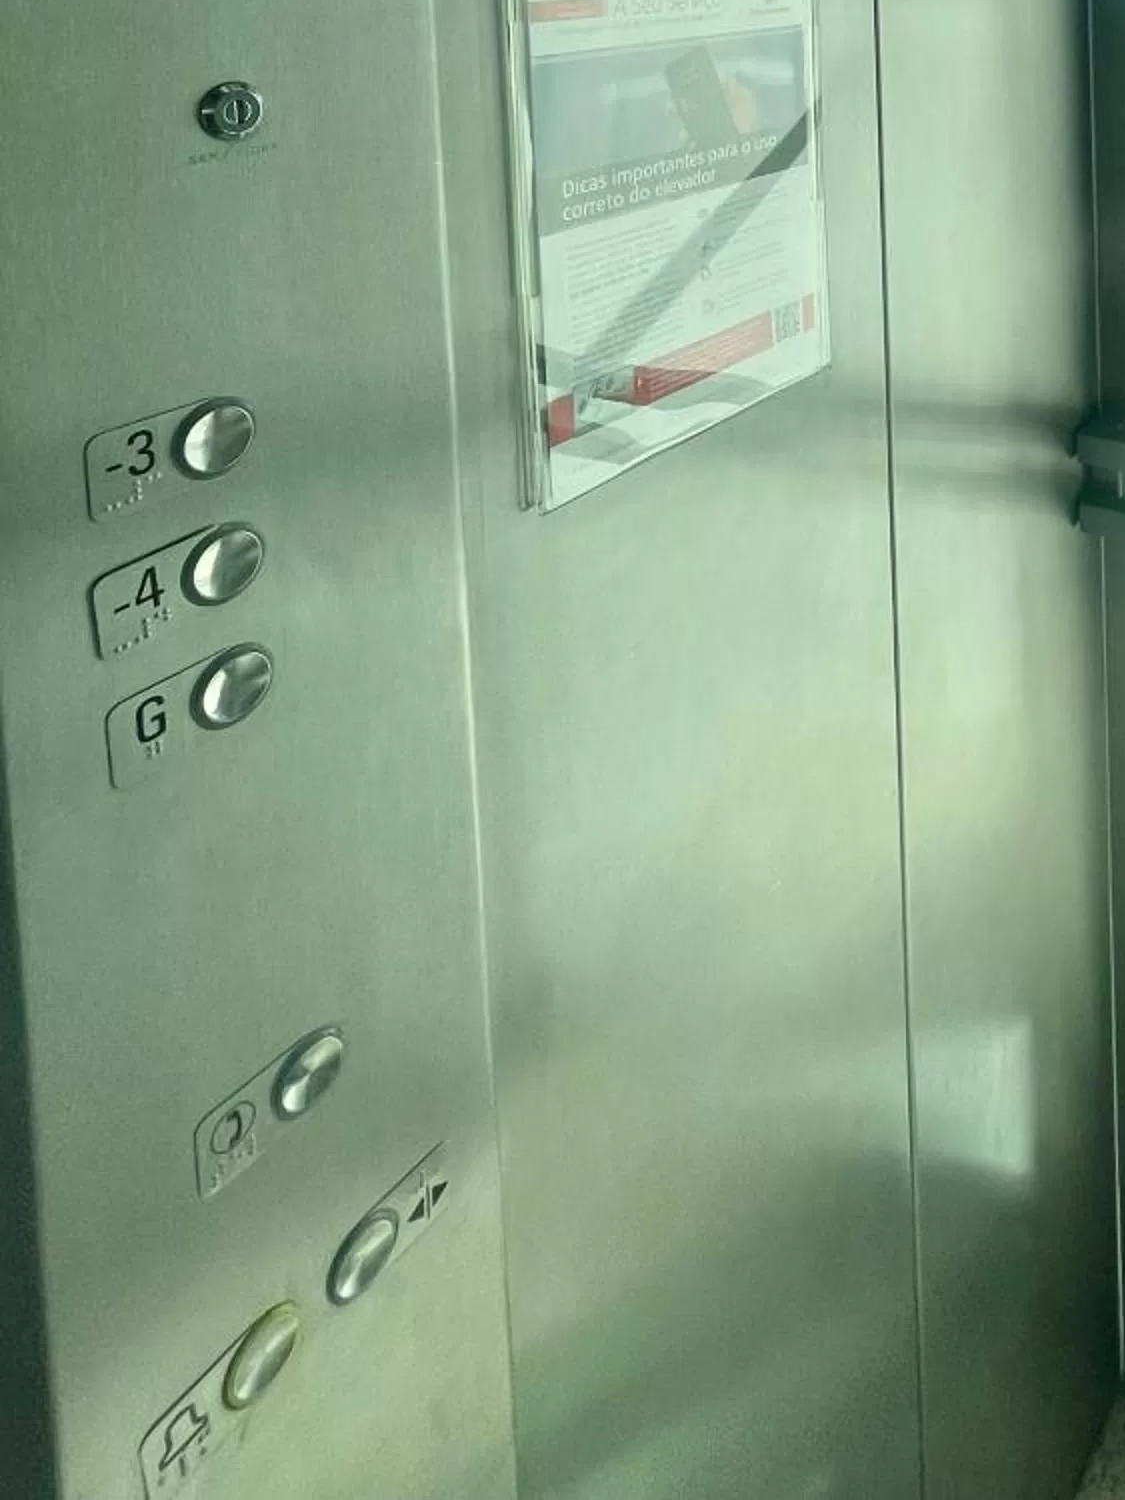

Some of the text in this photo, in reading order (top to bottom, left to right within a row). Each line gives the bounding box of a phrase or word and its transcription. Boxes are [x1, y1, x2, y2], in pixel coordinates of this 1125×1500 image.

[562, 177, 607, 199] Dicas
[612, 150, 704, 186] importantes
[707, 143, 738, 165] para
[741, 140, 752, 153] o
[562, 194, 625, 221] correto
[629, 185, 651, 204] do
[105, 428, 156, 477] -3
[113, 565, 165, 615] -4
[134, 694, 168, 744] G
